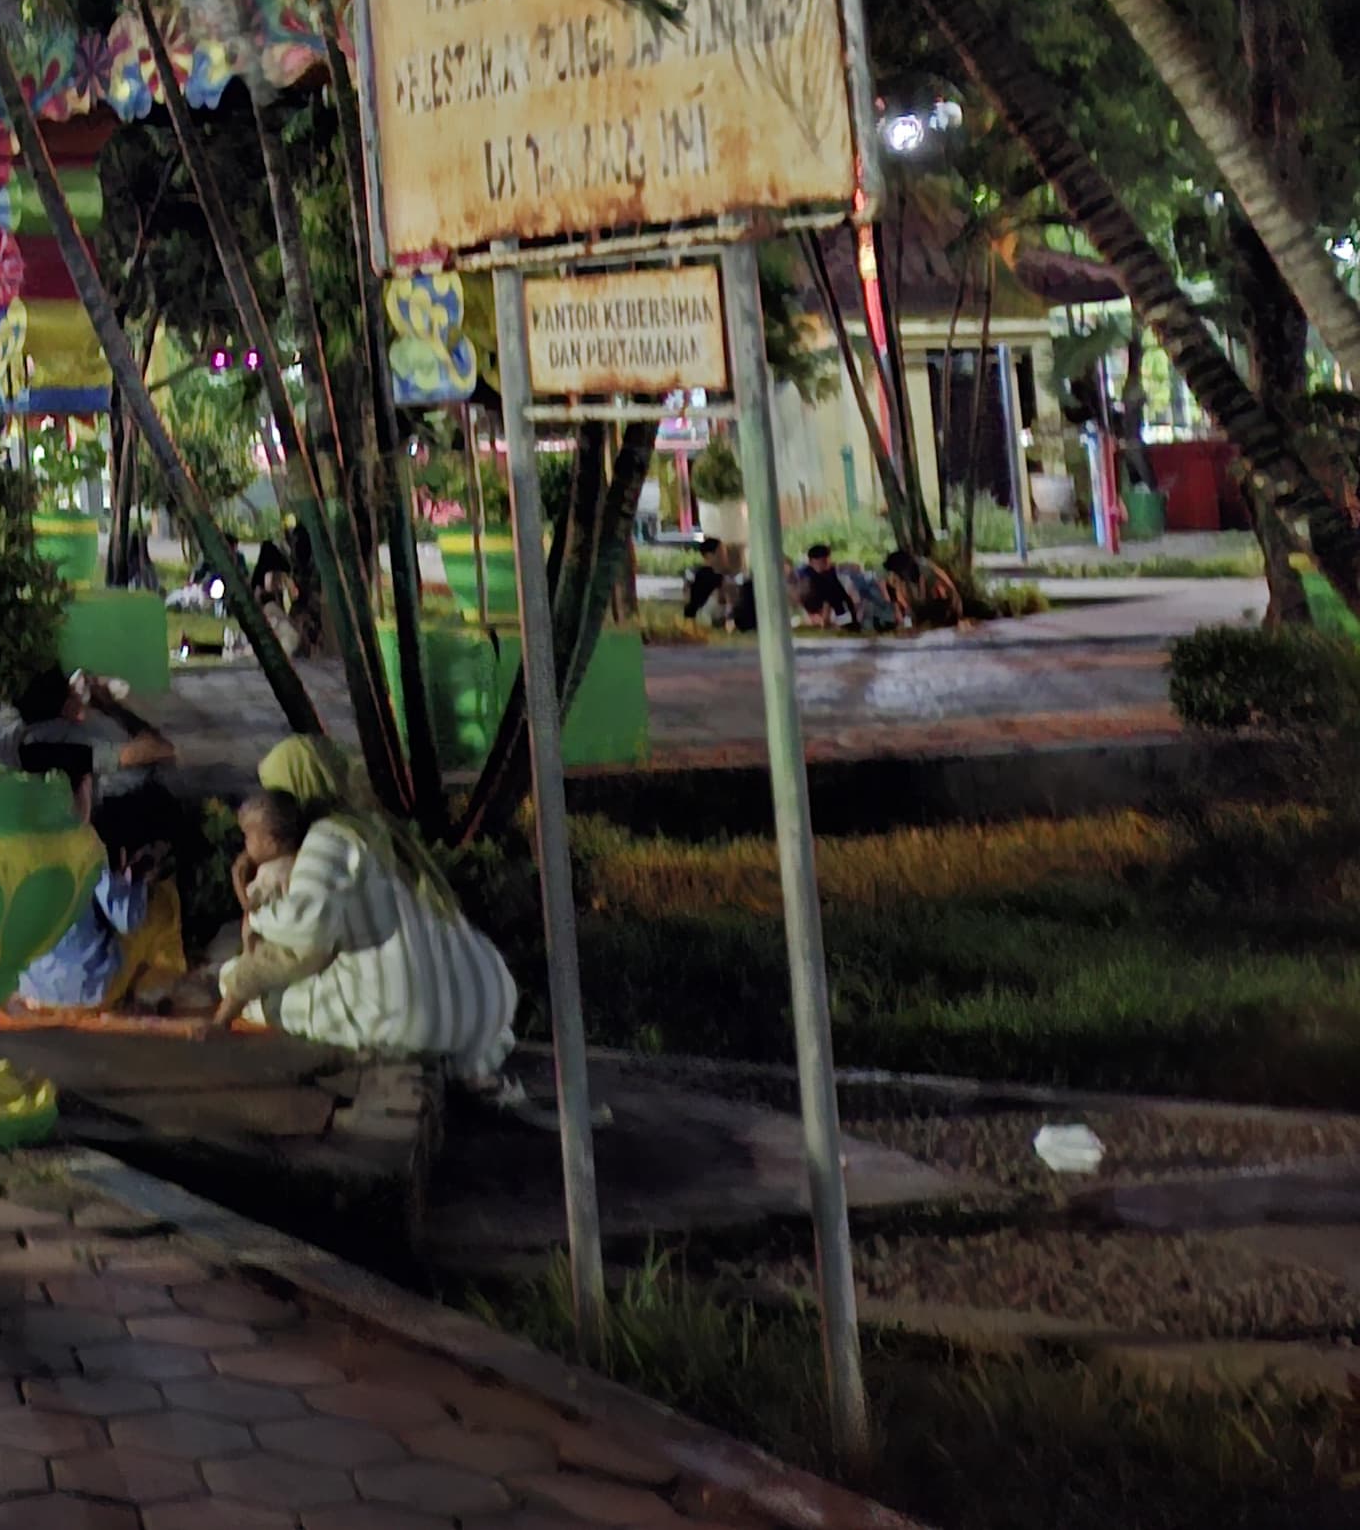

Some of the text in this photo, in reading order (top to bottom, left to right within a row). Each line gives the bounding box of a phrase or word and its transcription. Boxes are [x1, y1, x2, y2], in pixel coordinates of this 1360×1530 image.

[603, 295, 713, 329] KEBERSIHAN
[548, 336, 700, 368] DAN PERTAMANAN
